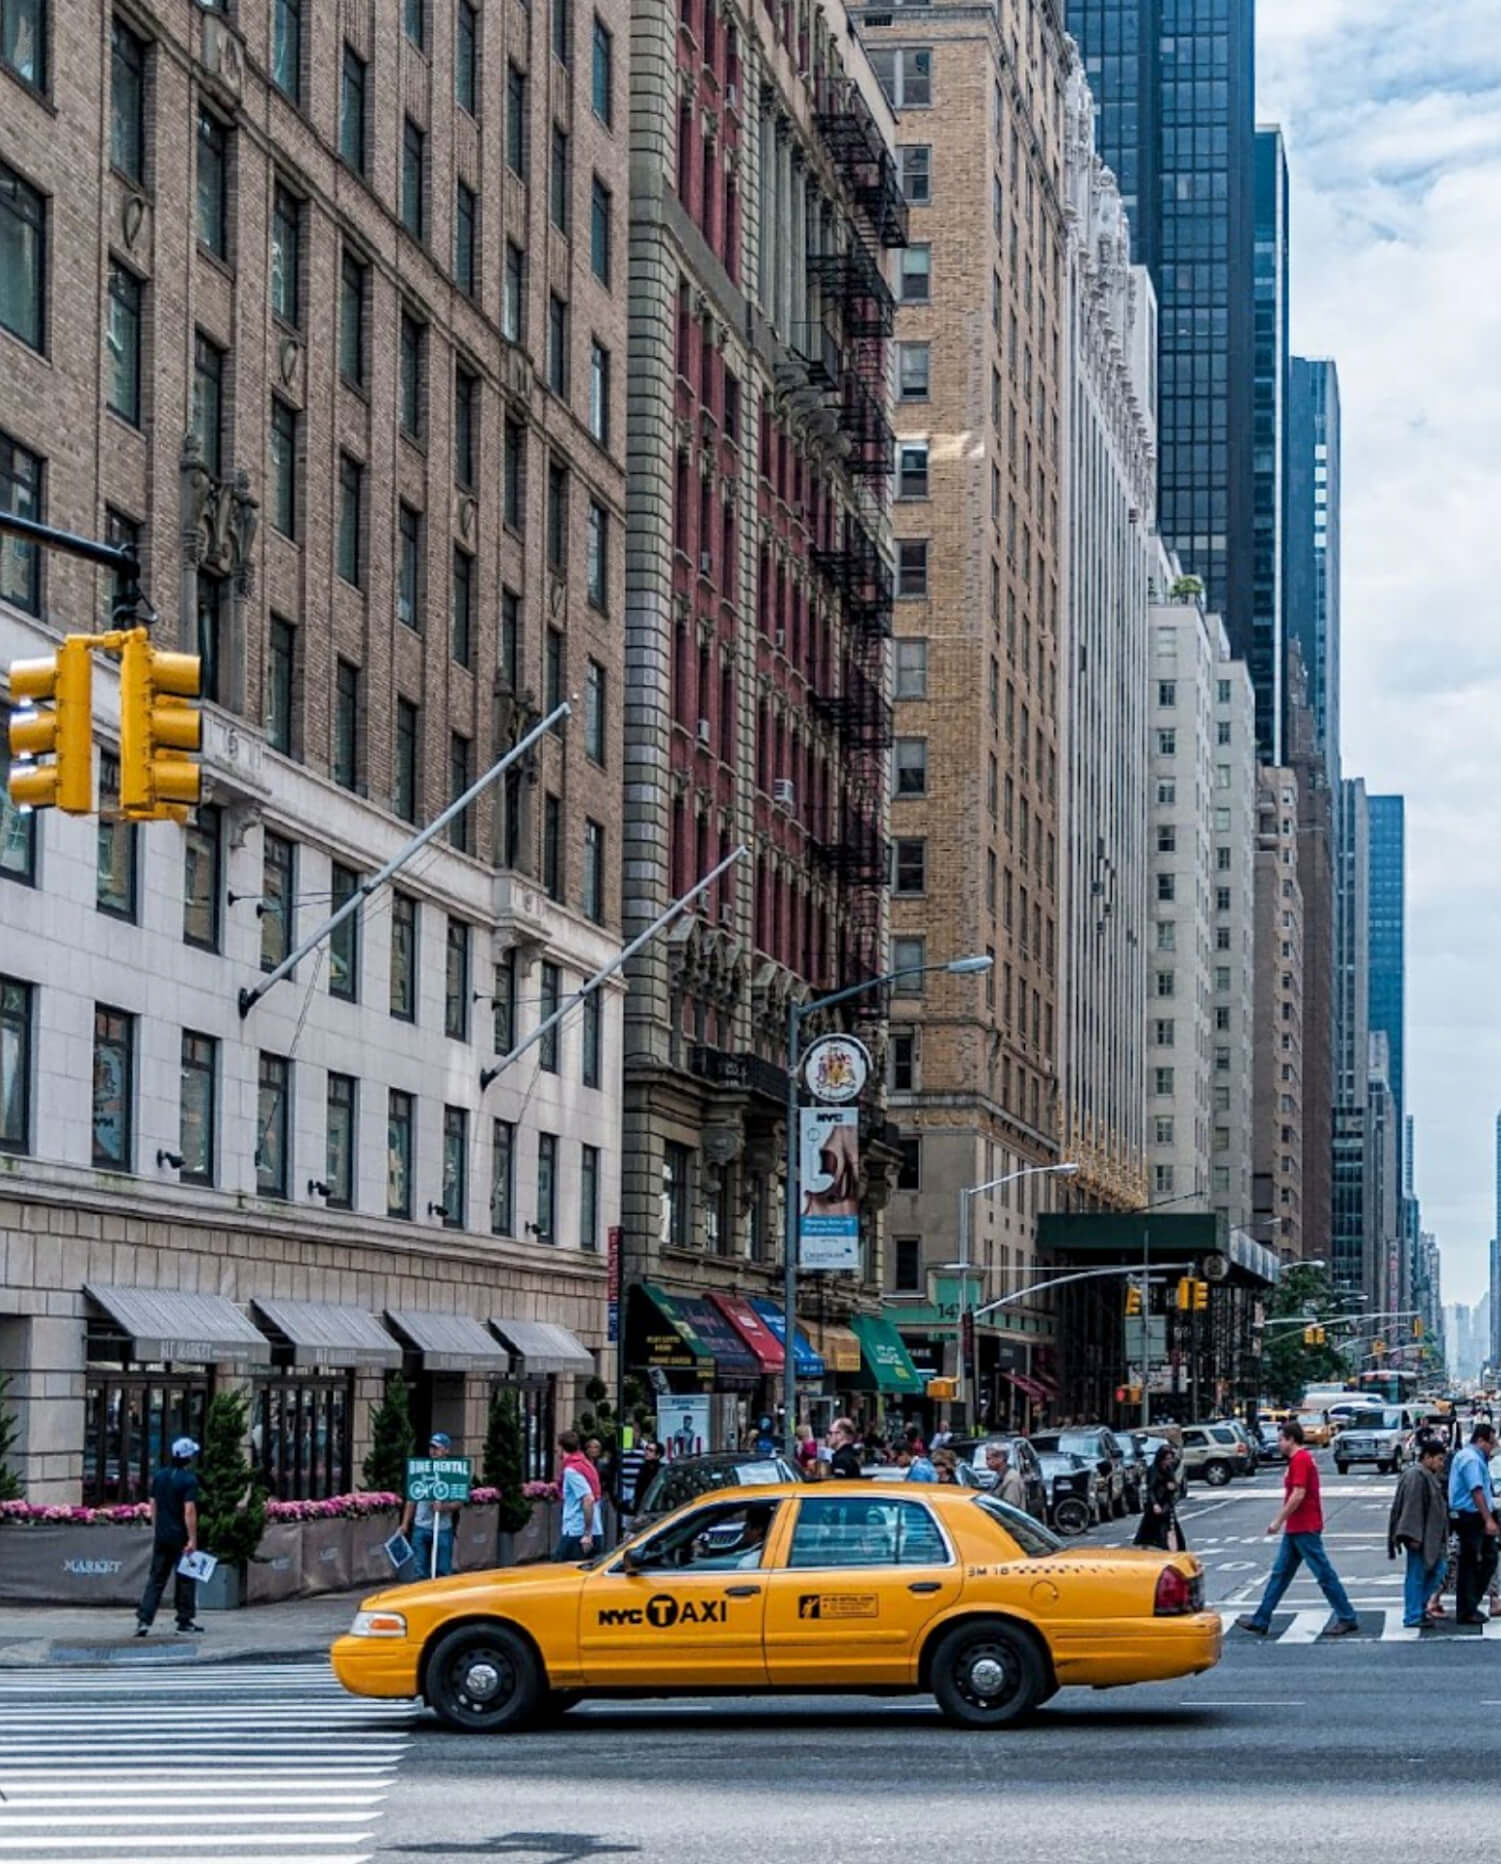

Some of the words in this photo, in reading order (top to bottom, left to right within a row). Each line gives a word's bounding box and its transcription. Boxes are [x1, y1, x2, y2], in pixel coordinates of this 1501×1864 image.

[816, 1113, 844, 1122] NYC
[409, 1460, 432, 1474] BIKE
[433, 1460, 469, 1475] RENTAL
[63, 1559, 122, 1574] MARKET
[598, 1608, 643, 1626] NYC
[647, 1597, 727, 1627] TAXI
